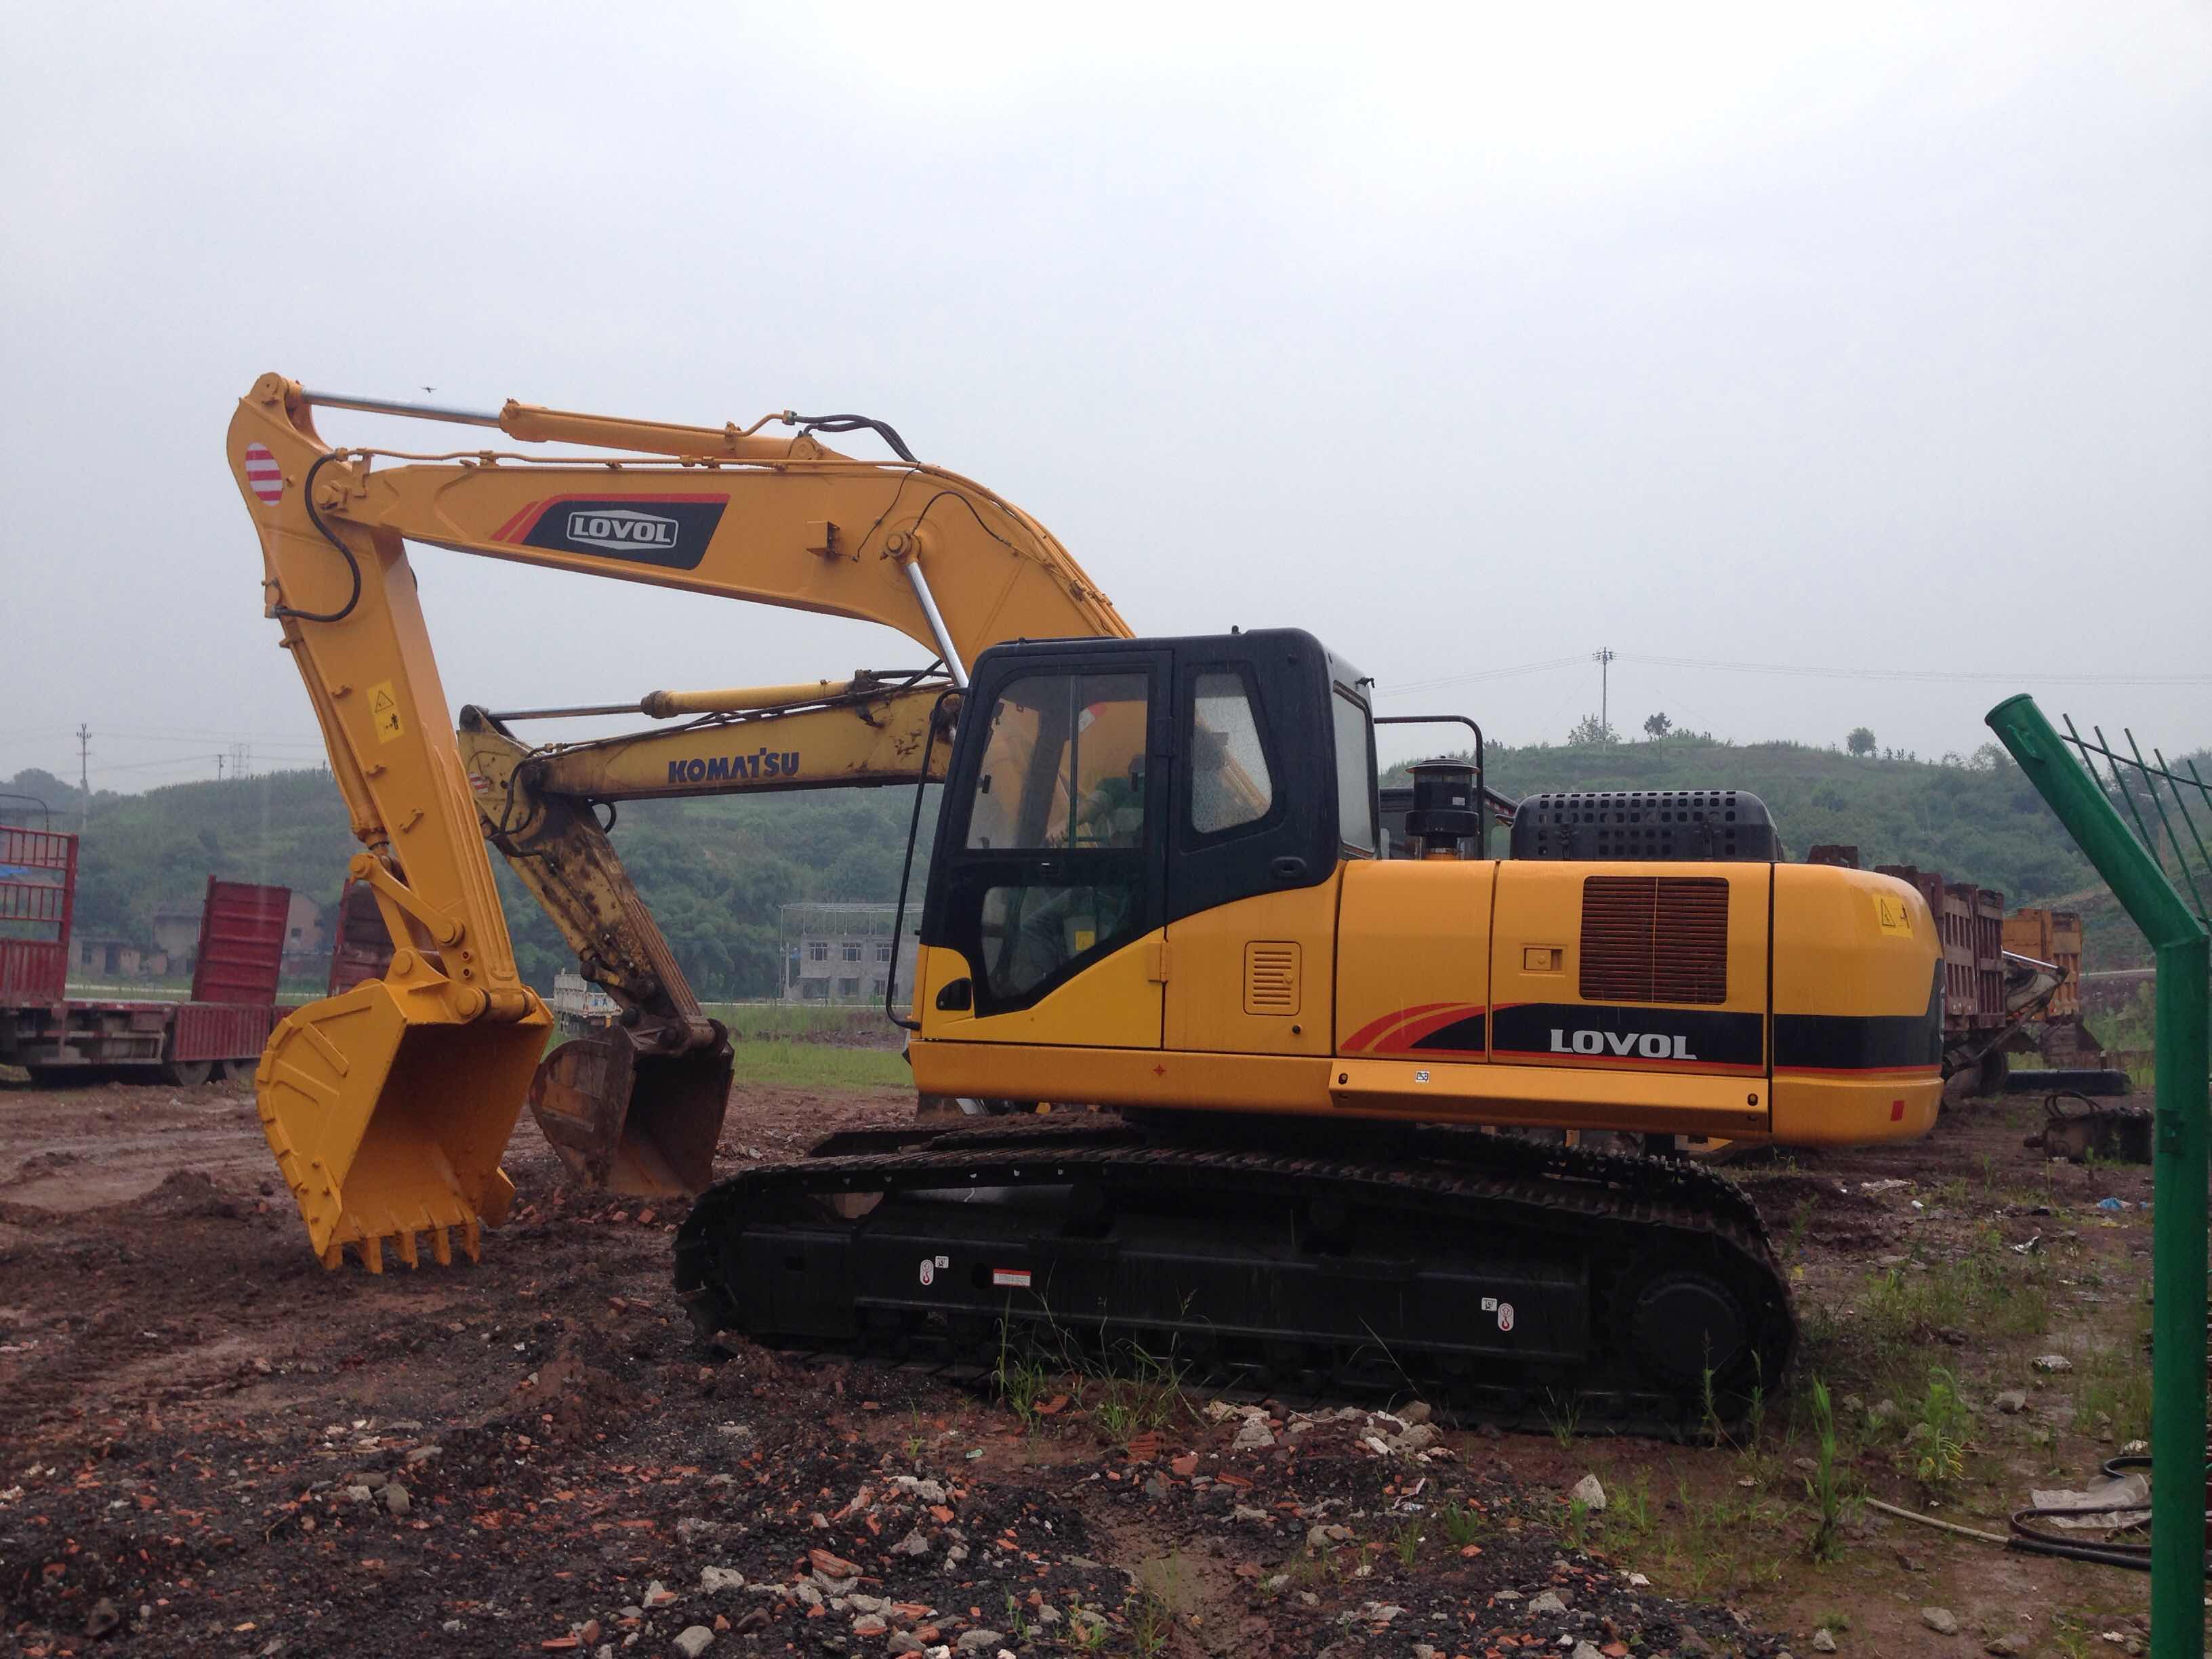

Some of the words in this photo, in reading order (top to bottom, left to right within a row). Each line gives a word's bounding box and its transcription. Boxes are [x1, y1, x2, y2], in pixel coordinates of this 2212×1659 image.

[574, 517, 671, 542] LOVOL
[668, 747, 800, 783] KOMATSU
[1551, 1029, 1698, 1060] LOVOL
